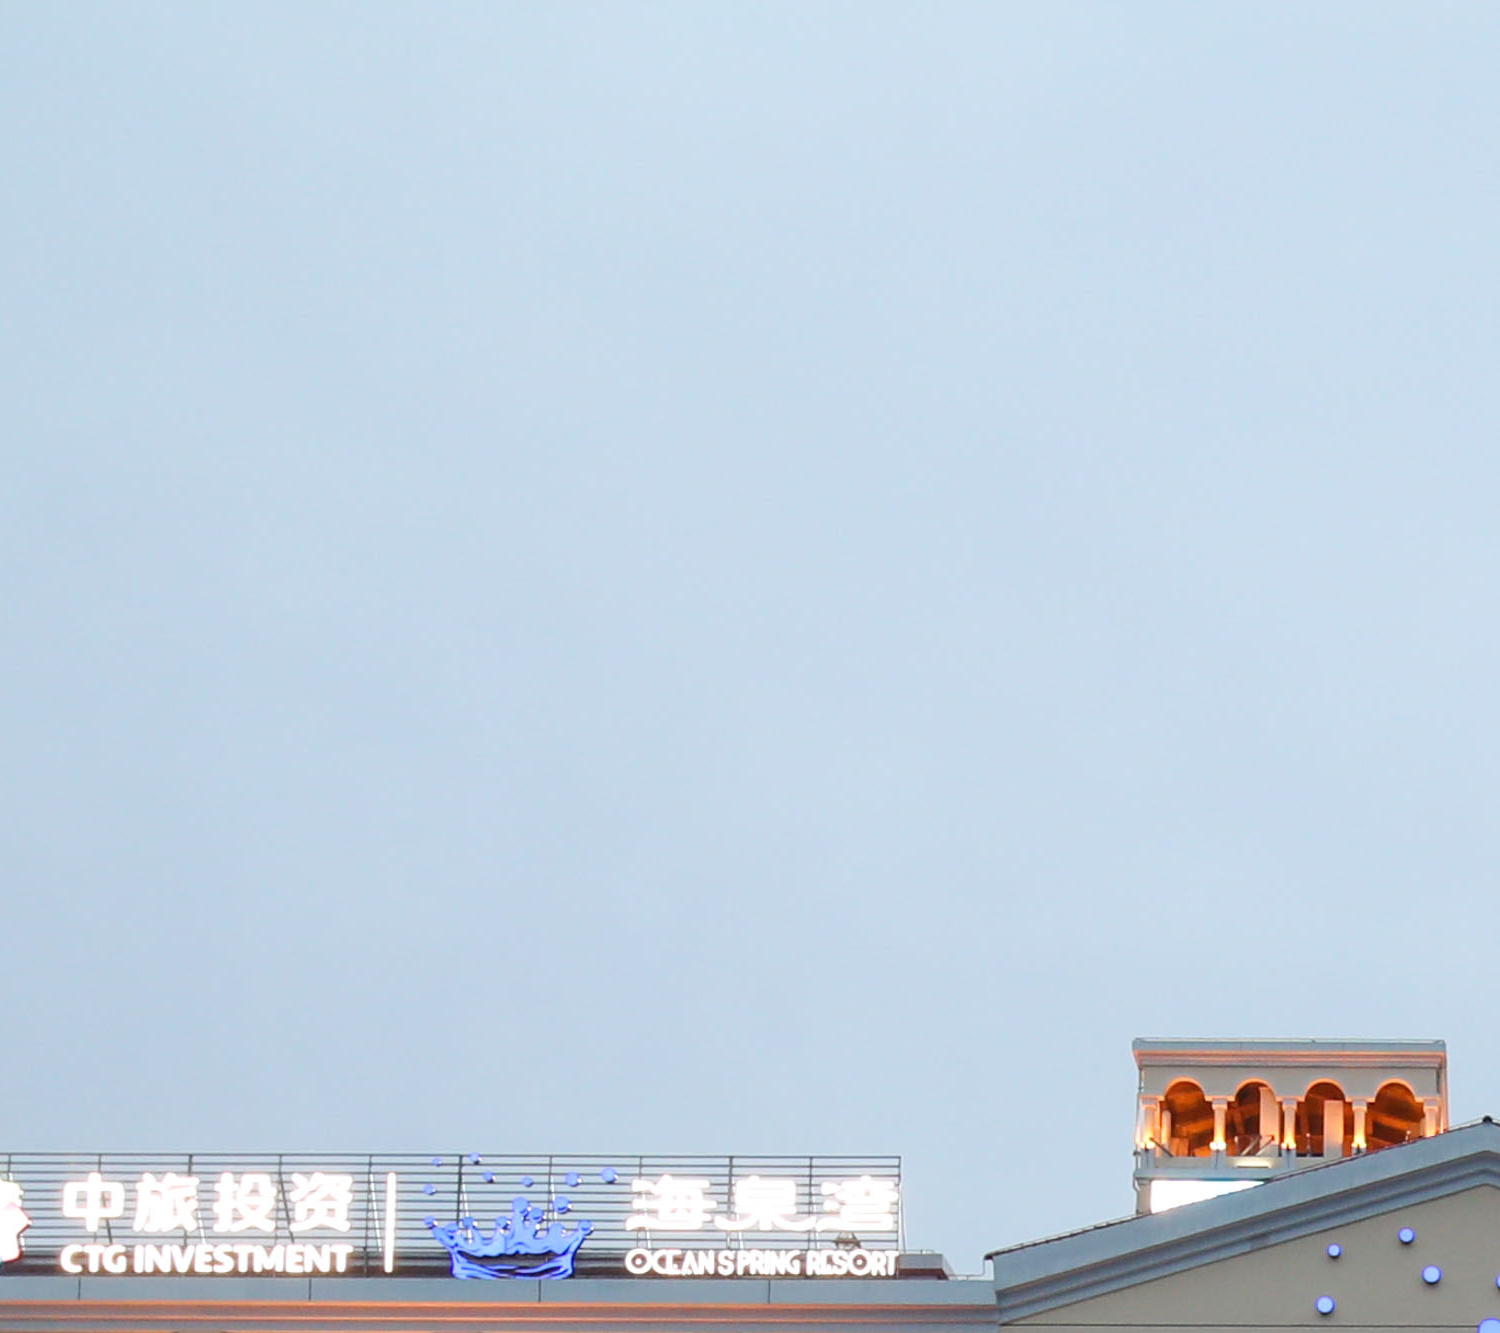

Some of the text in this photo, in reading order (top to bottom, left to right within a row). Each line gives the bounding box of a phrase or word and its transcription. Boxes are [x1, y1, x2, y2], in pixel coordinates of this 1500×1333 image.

[61, 1171, 354, 1233] 中旅投资
[625, 1174, 899, 1232] 海泉湾
[60, 1243, 354, 1274] CTG INVESTMENT
[625, 1248, 716, 1276] OCEAN
[717, 1249, 801, 1276] SPRING
